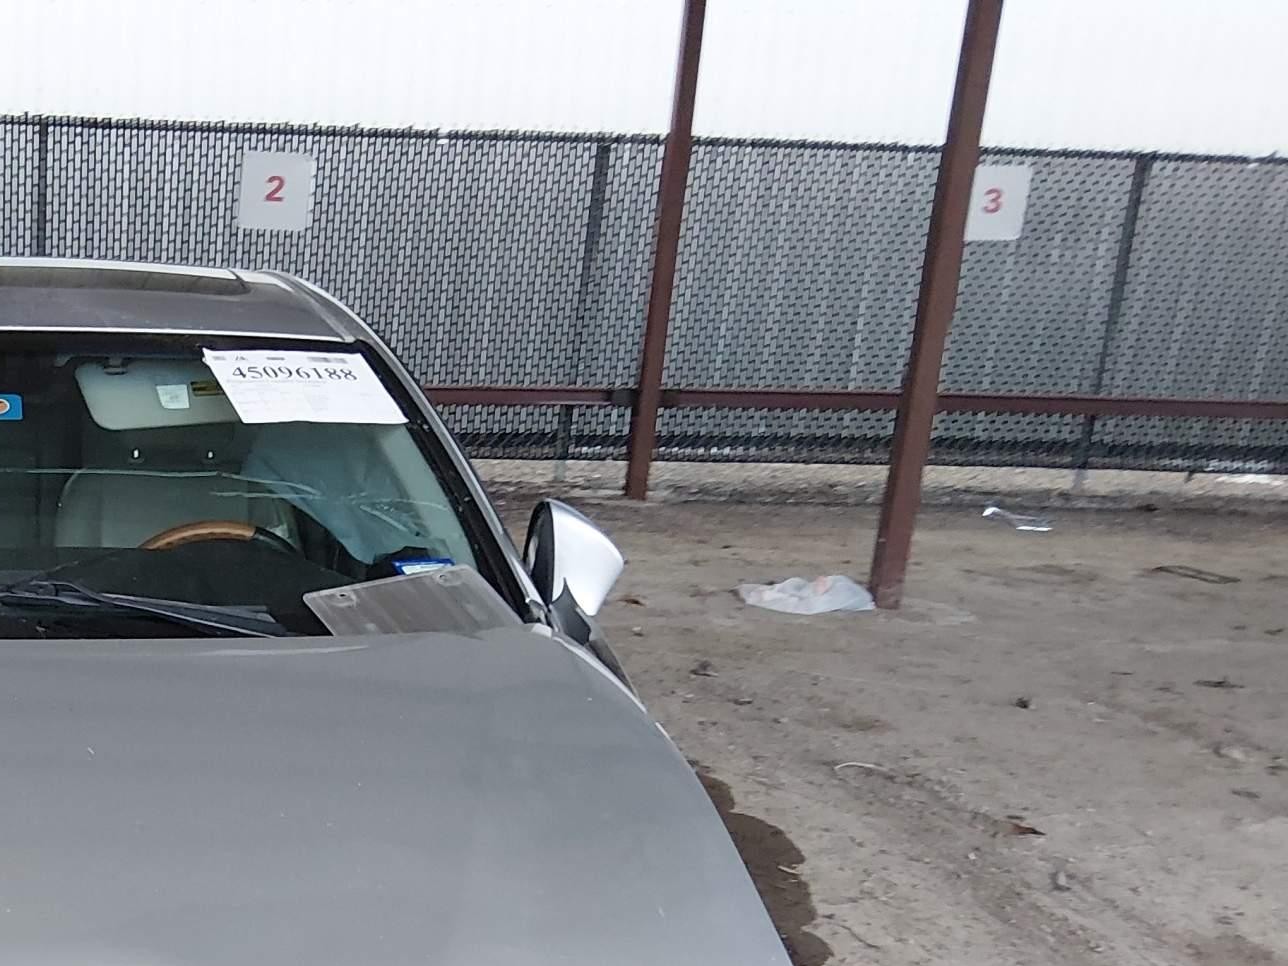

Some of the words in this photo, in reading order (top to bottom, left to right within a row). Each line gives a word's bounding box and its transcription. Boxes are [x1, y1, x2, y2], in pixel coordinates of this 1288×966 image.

[264, 175, 285, 202] 2
[983, 188, 1002, 214] 3
[232, 366, 358, 381] 45096188
